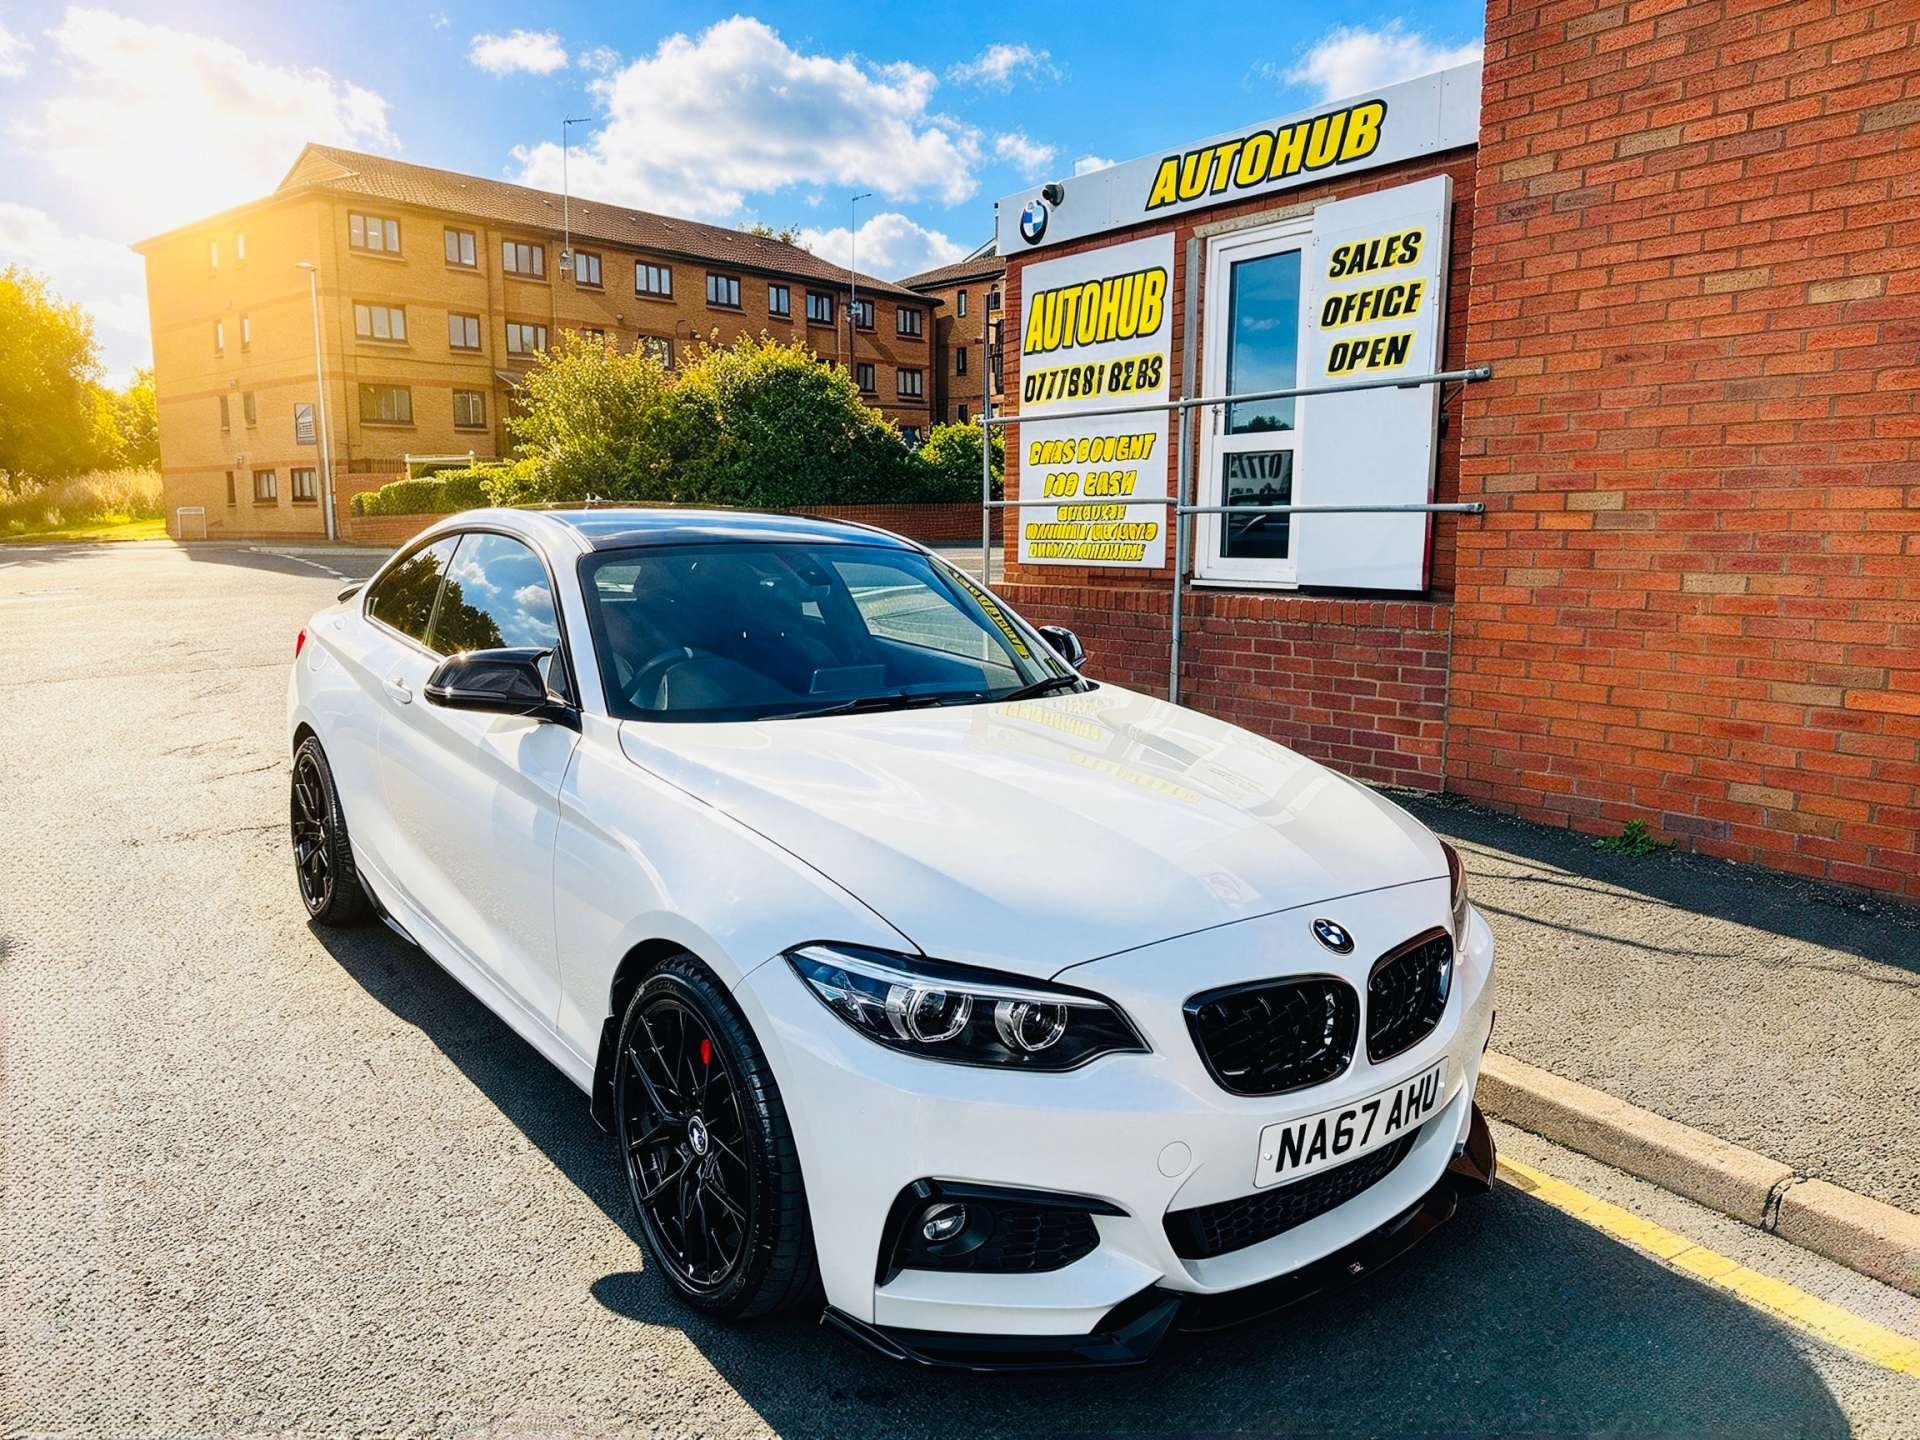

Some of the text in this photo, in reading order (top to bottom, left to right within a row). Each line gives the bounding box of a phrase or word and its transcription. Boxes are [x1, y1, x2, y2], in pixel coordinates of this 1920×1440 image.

[1144, 99, 1388, 211] AUTOHUB
[1329, 231, 1422, 278] SALES
[1023, 266, 1168, 356] AUTOHUB
[1320, 283, 1422, 327] OFFICE
[1327, 334, 1412, 373] OPEN
[1275, 1068, 1440, 1173] NA67 AHU
